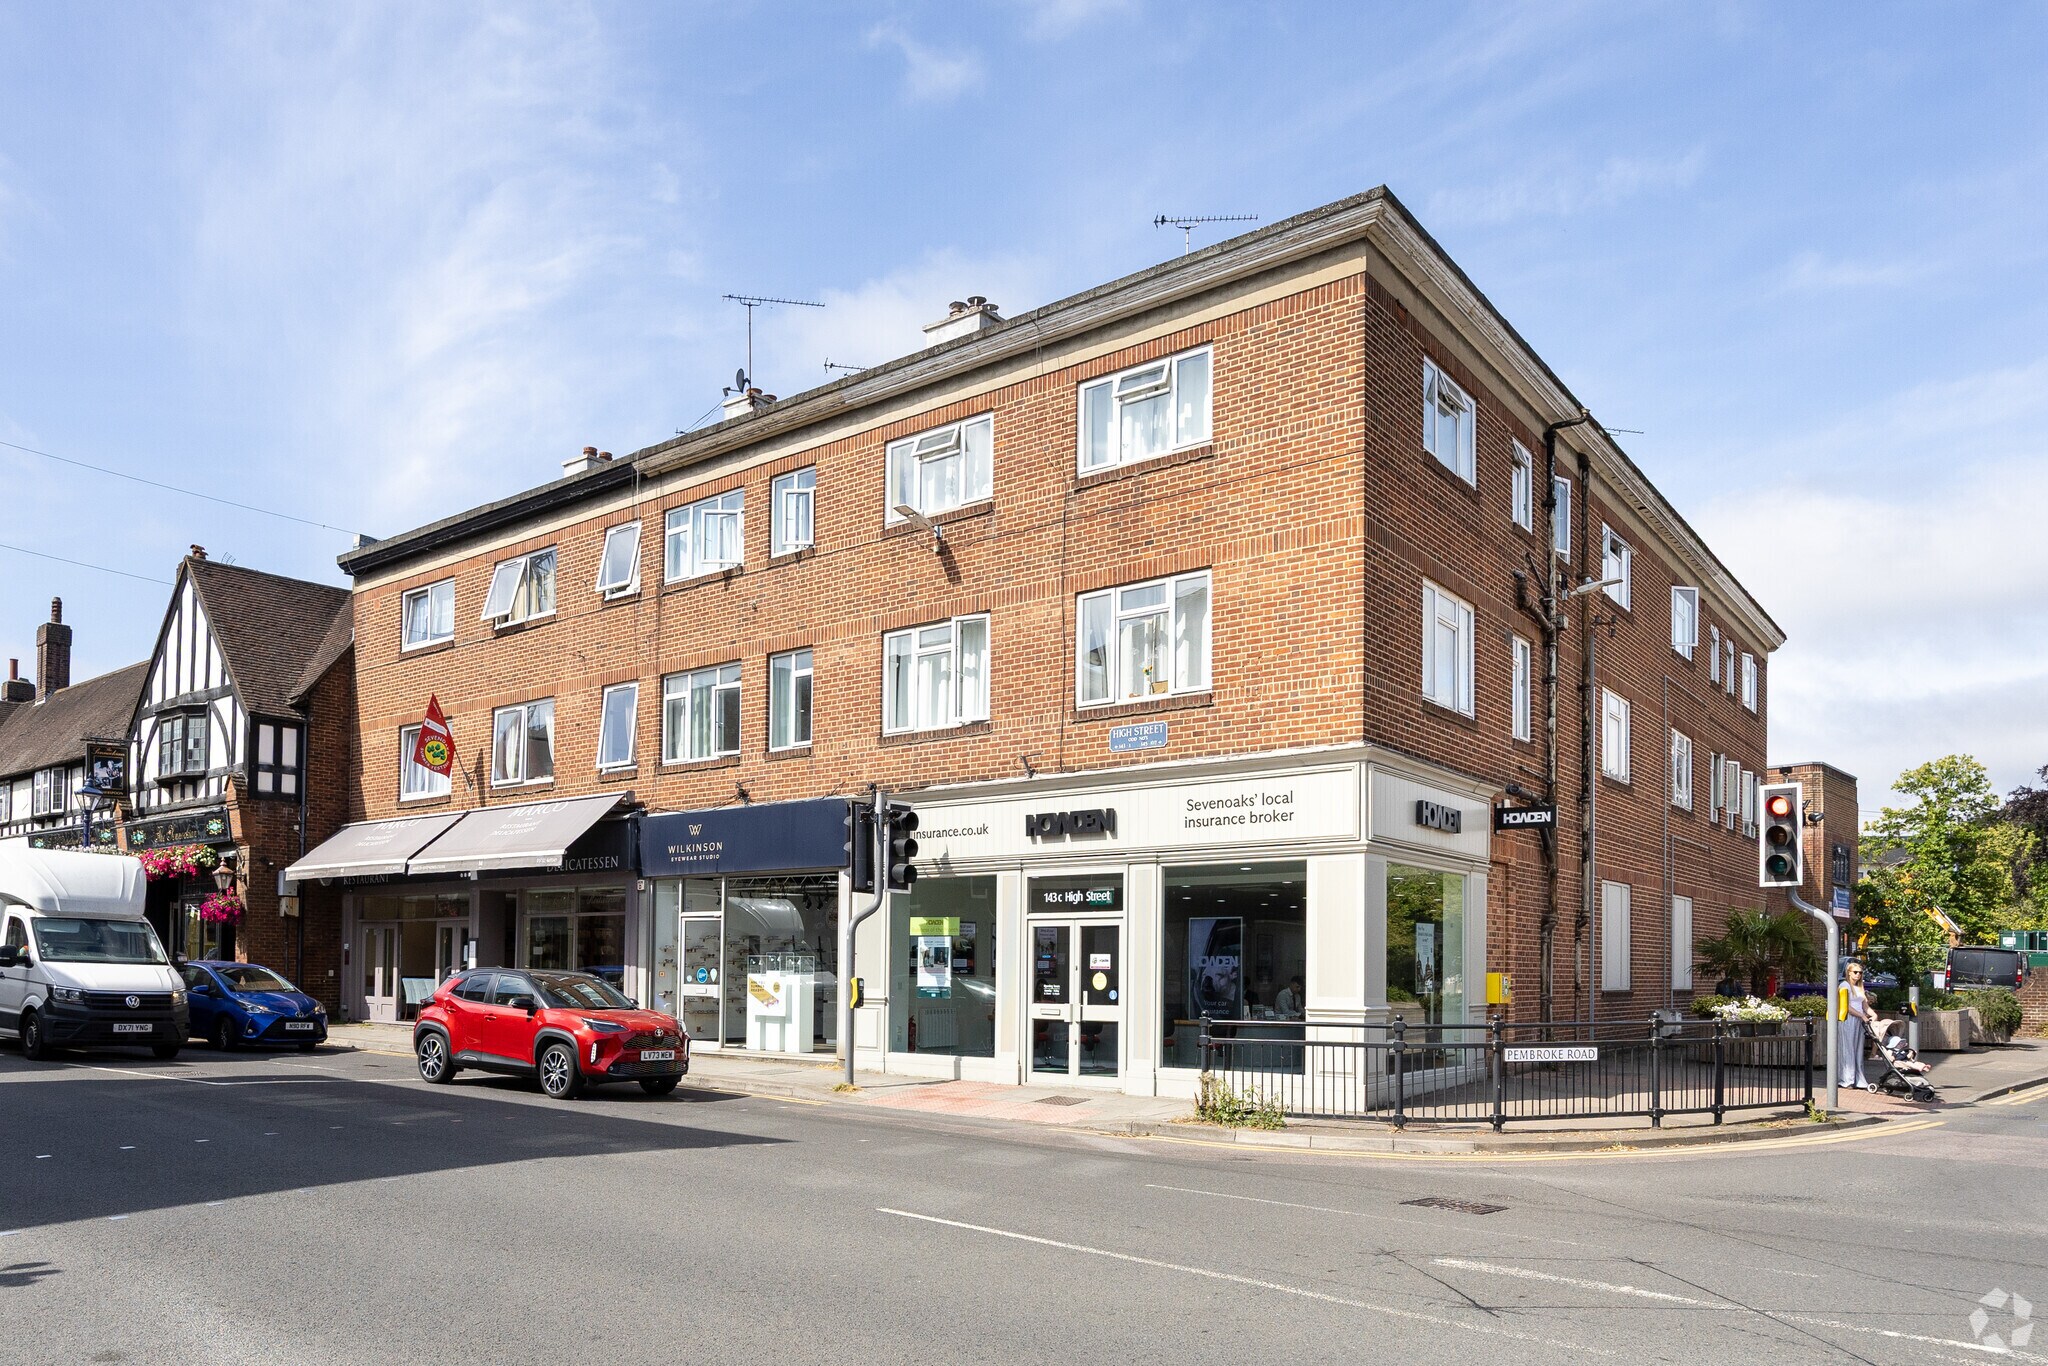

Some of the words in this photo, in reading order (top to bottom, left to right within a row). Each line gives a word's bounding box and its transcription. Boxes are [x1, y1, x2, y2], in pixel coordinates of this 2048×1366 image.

[1112, 728, 1132, 738] HIGH
[1134, 724, 1164, 736] STREET
[1262, 790, 1293, 806] local
[508, 801, 569, 818] MARCO
[1417, 800, 1461, 834] HOWDEN
[1025, 808, 1115, 837] HOWDEN
[1184, 814, 1246, 828] insurance
[1249, 809, 1294, 824] broker
[1503, 812, 1552, 824] HOWDEN
[667, 841, 723, 854] WILKINSON
[1064, 890, 1084, 905] High
[1085, 890, 1111, 902] Street
[1507, 1049, 1564, 1060] PEMBROKE
[1567, 1048, 1596, 1060] ROAD
